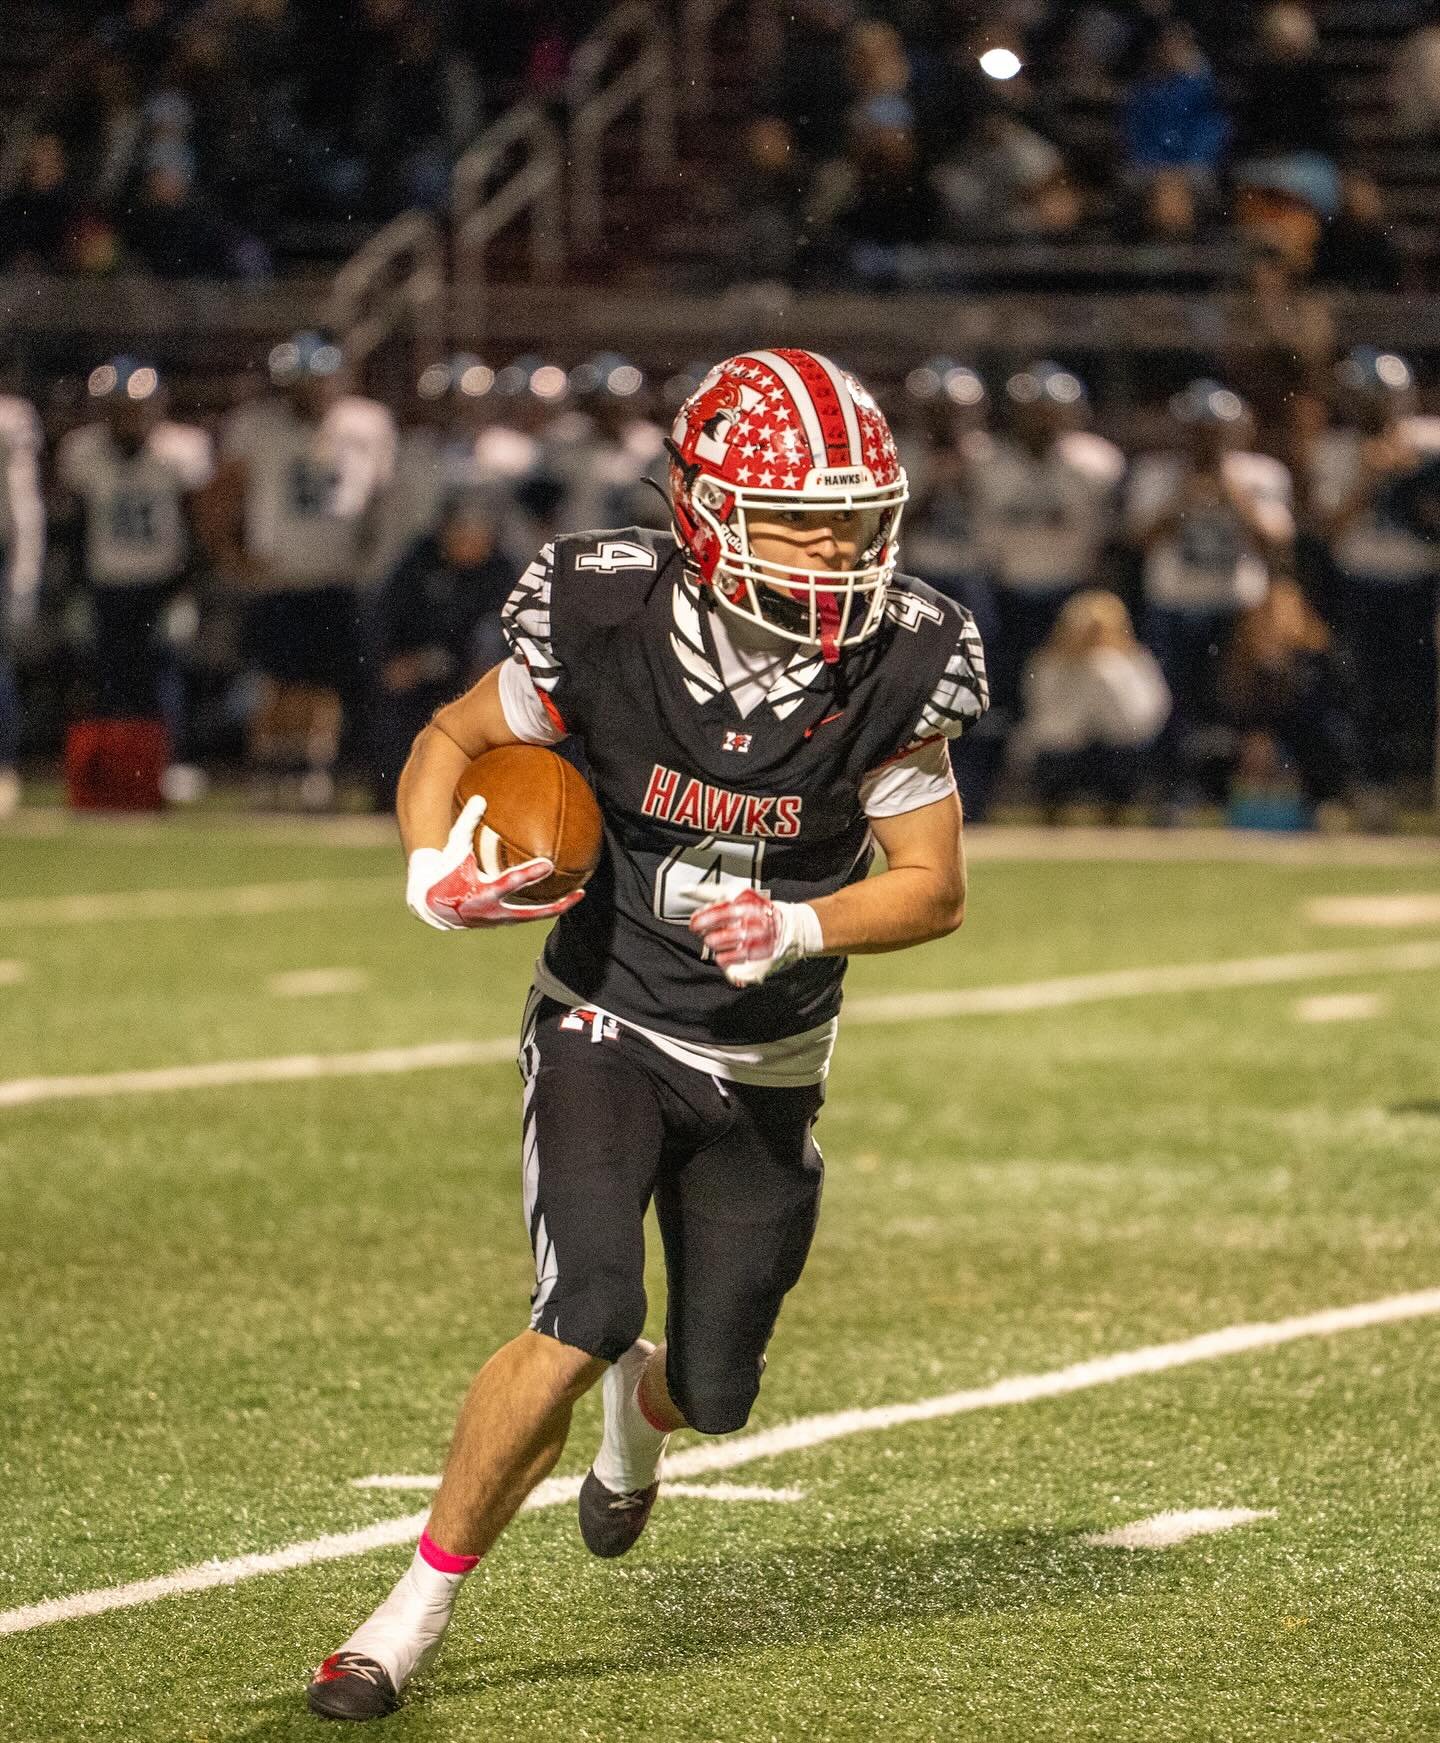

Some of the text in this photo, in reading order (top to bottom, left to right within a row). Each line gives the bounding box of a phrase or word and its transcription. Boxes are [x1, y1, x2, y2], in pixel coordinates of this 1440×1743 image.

[824, 474, 860, 486] HAWKS
[575, 541, 658, 574] 4
[884, 590, 945, 633] 4
[641, 763, 802, 838] HAWKS
[654, 833, 770, 960] 4
